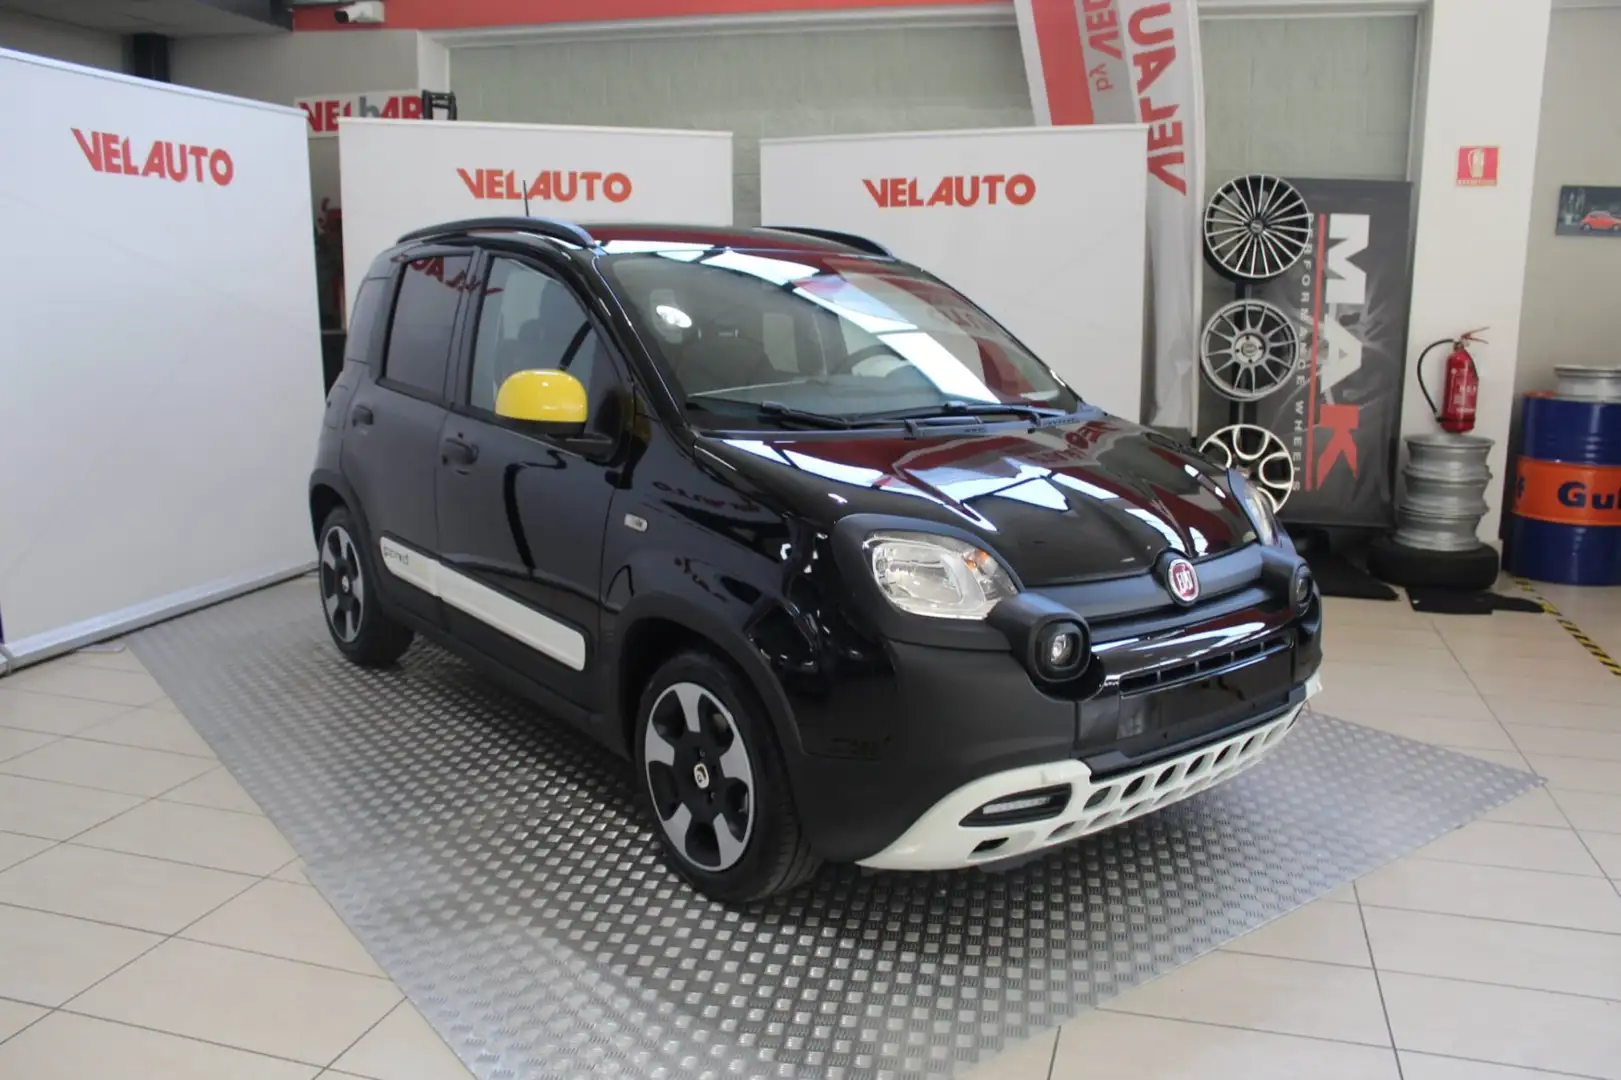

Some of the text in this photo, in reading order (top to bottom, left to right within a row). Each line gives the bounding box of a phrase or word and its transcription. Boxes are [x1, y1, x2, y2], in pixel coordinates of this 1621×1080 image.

[72, 129, 234, 186] VELAUTO
[457, 168, 632, 203] VELAUTO
[862, 174, 1036, 208] VELAUTO
[1317, 213, 1371, 490] MAK
